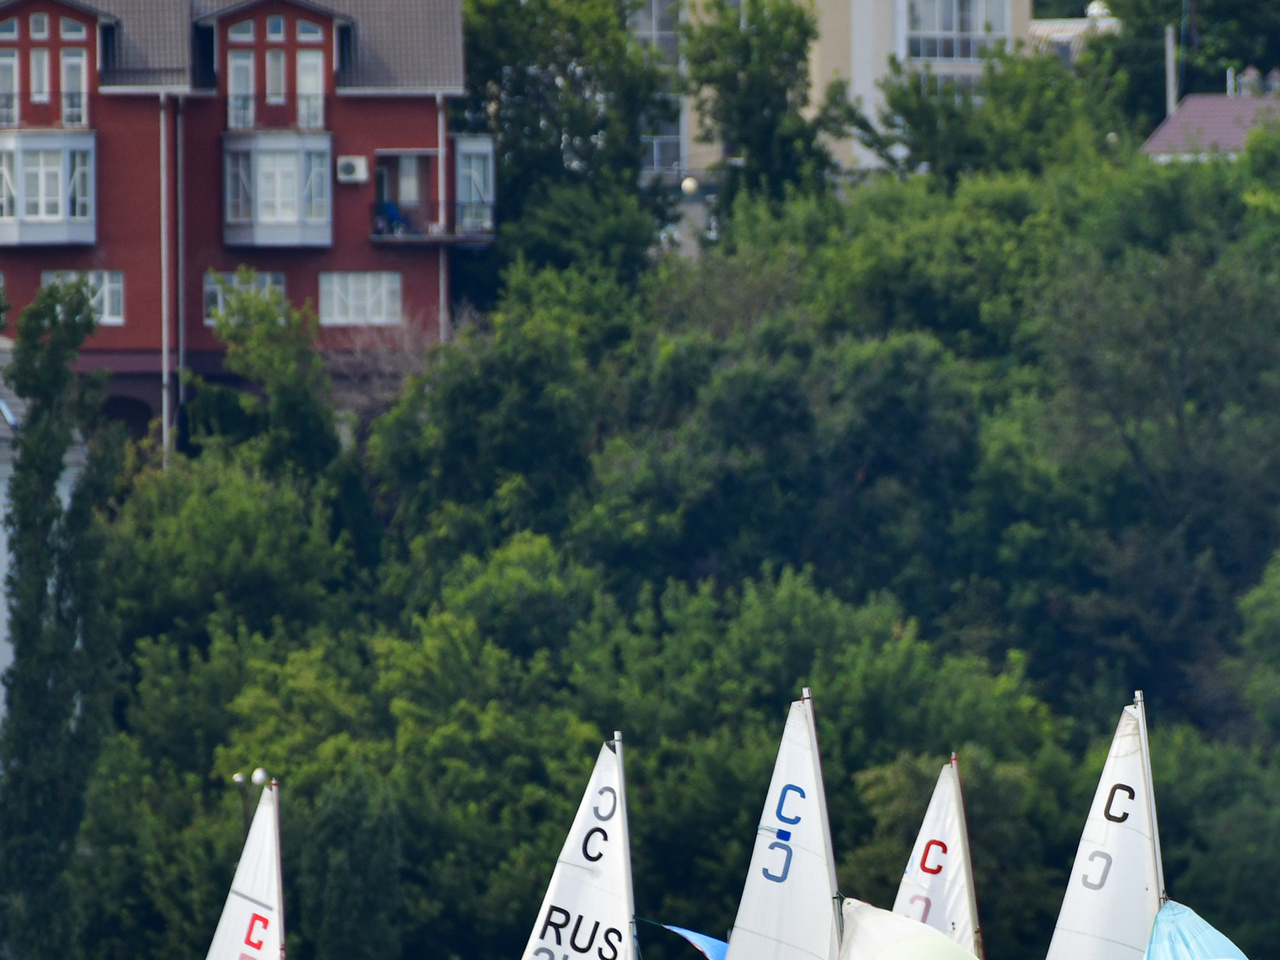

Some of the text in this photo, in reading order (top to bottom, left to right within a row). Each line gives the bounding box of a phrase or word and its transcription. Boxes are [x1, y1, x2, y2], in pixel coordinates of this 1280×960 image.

[776, 783, 806, 825] C
[1104, 783, 1135, 823] C
[582, 827, 608, 862] C
[920, 839, 947, 875] C
[244, 912, 269, 950] C
